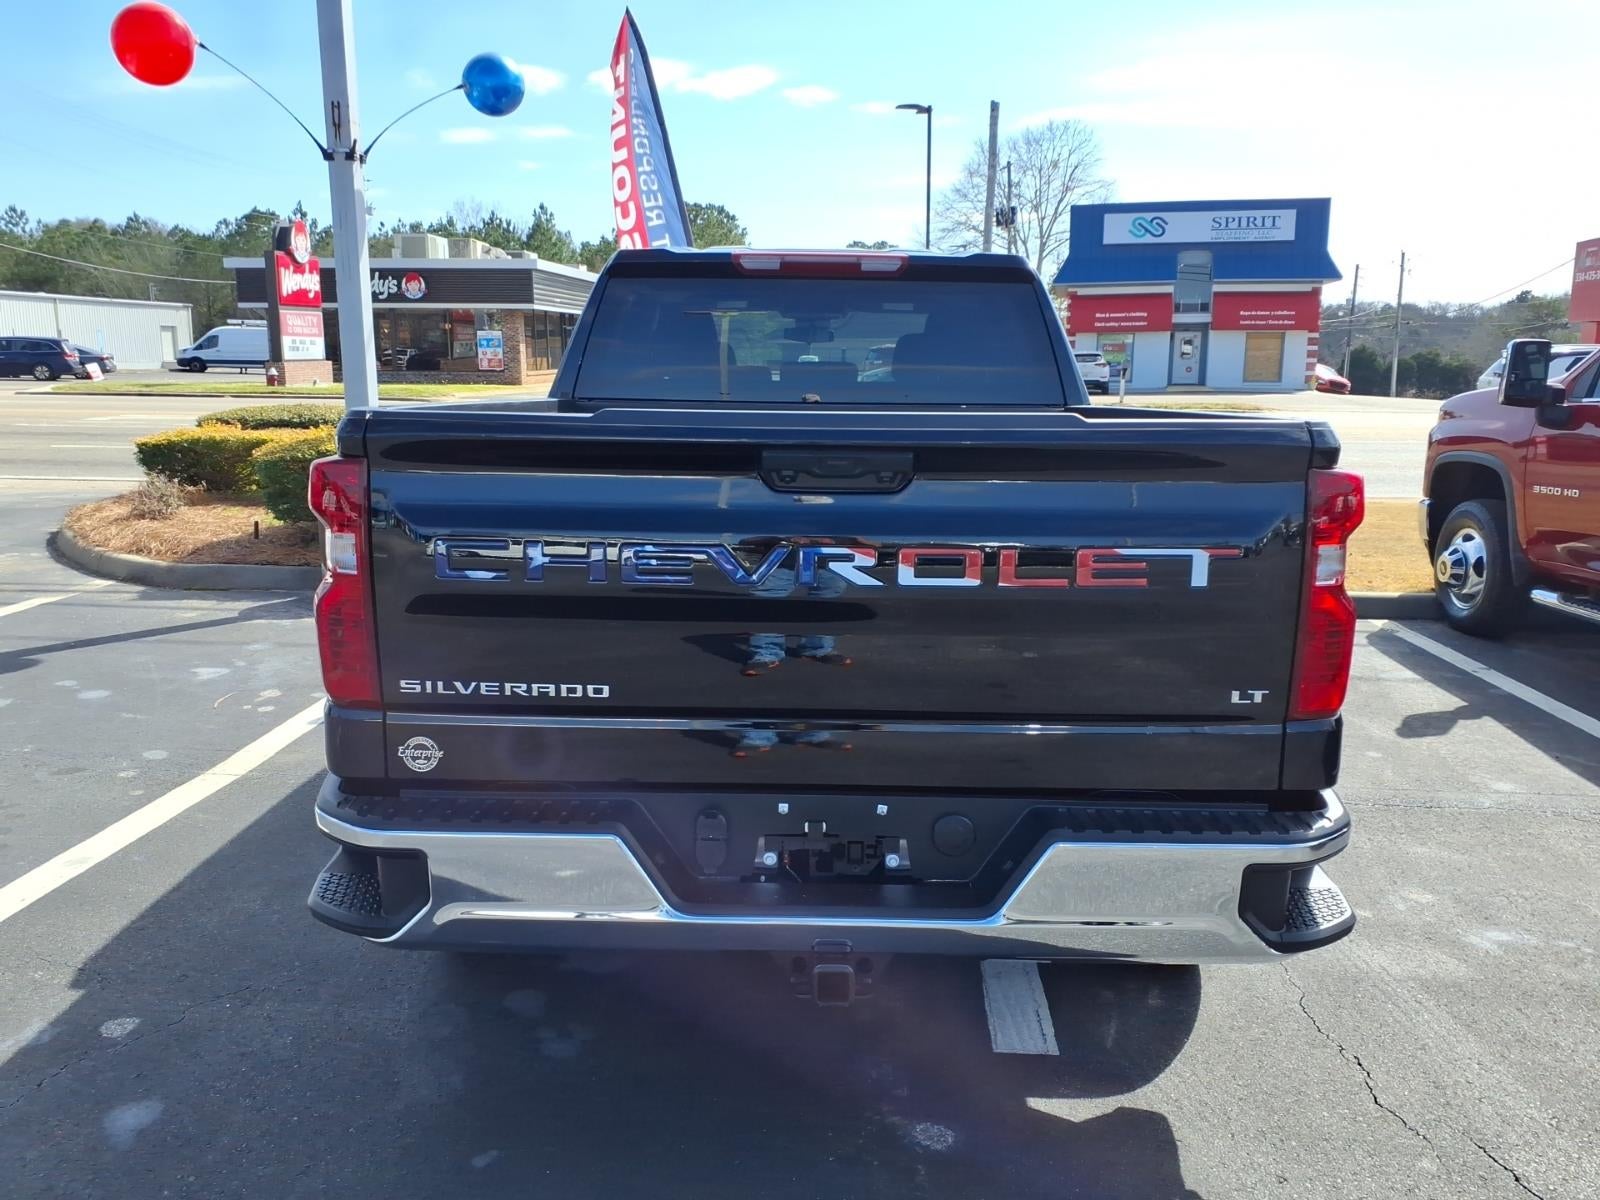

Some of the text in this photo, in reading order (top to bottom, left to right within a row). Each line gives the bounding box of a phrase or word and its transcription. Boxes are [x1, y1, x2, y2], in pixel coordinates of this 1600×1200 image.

[1211, 215, 1281, 229] SPIRIT
[281, 264, 320, 299] Wendy's
[371, 272, 398, 299] dy's
[286, 314, 318, 327] QUALITY
[1533, 485, 1580, 497] 3500 HD
[433, 537, 1245, 588] CHEVROLET
[399, 679, 610, 698] SILVERADO
[1231, 690, 1270, 704] LT
[397, 746, 444, 760] Enterprise
